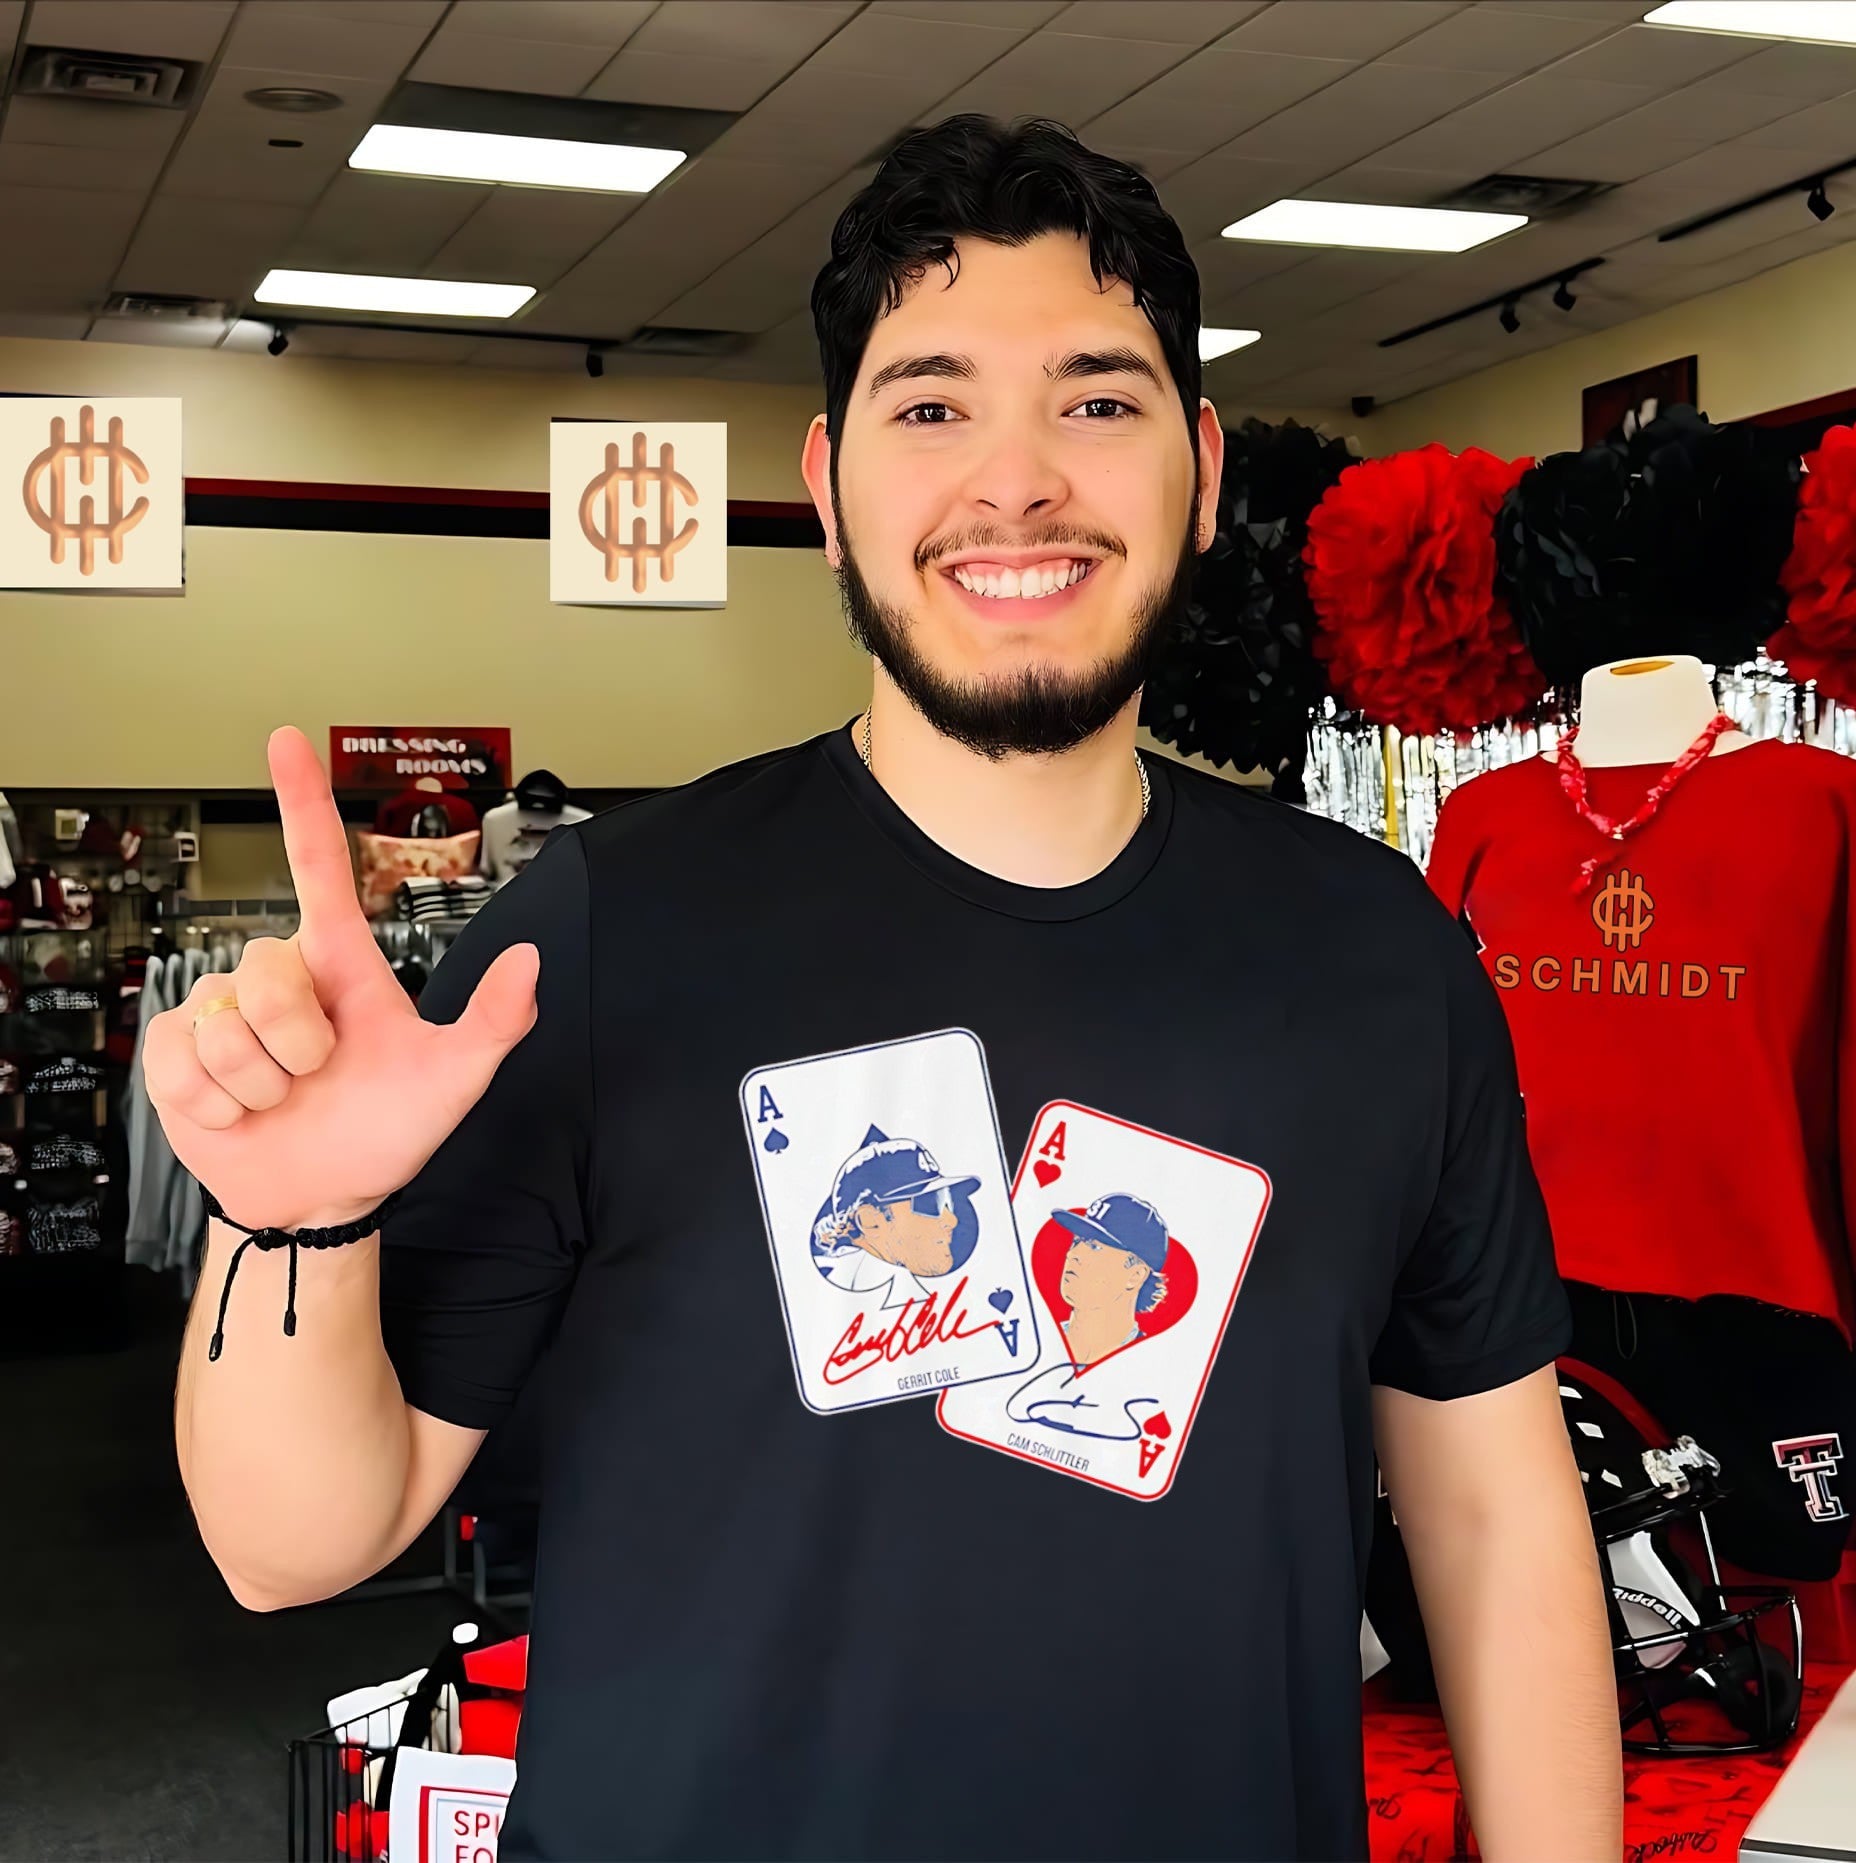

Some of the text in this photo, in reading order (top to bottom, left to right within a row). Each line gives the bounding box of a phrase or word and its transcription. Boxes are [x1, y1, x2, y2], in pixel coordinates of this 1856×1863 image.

[342, 737, 467, 754] DRESSING
[396, 758, 487, 774] ROOMS
[1494, 953, 1748, 1001] SCHMIDT
[757, 1085, 783, 1122] A
[1039, 1121, 1067, 1161] A
[1086, 1199, 1111, 1220] 31
[897, 1366, 961, 1391] GERRIT COLE
[1006, 1432, 1090, 1472] CAM SCHLITTLER
